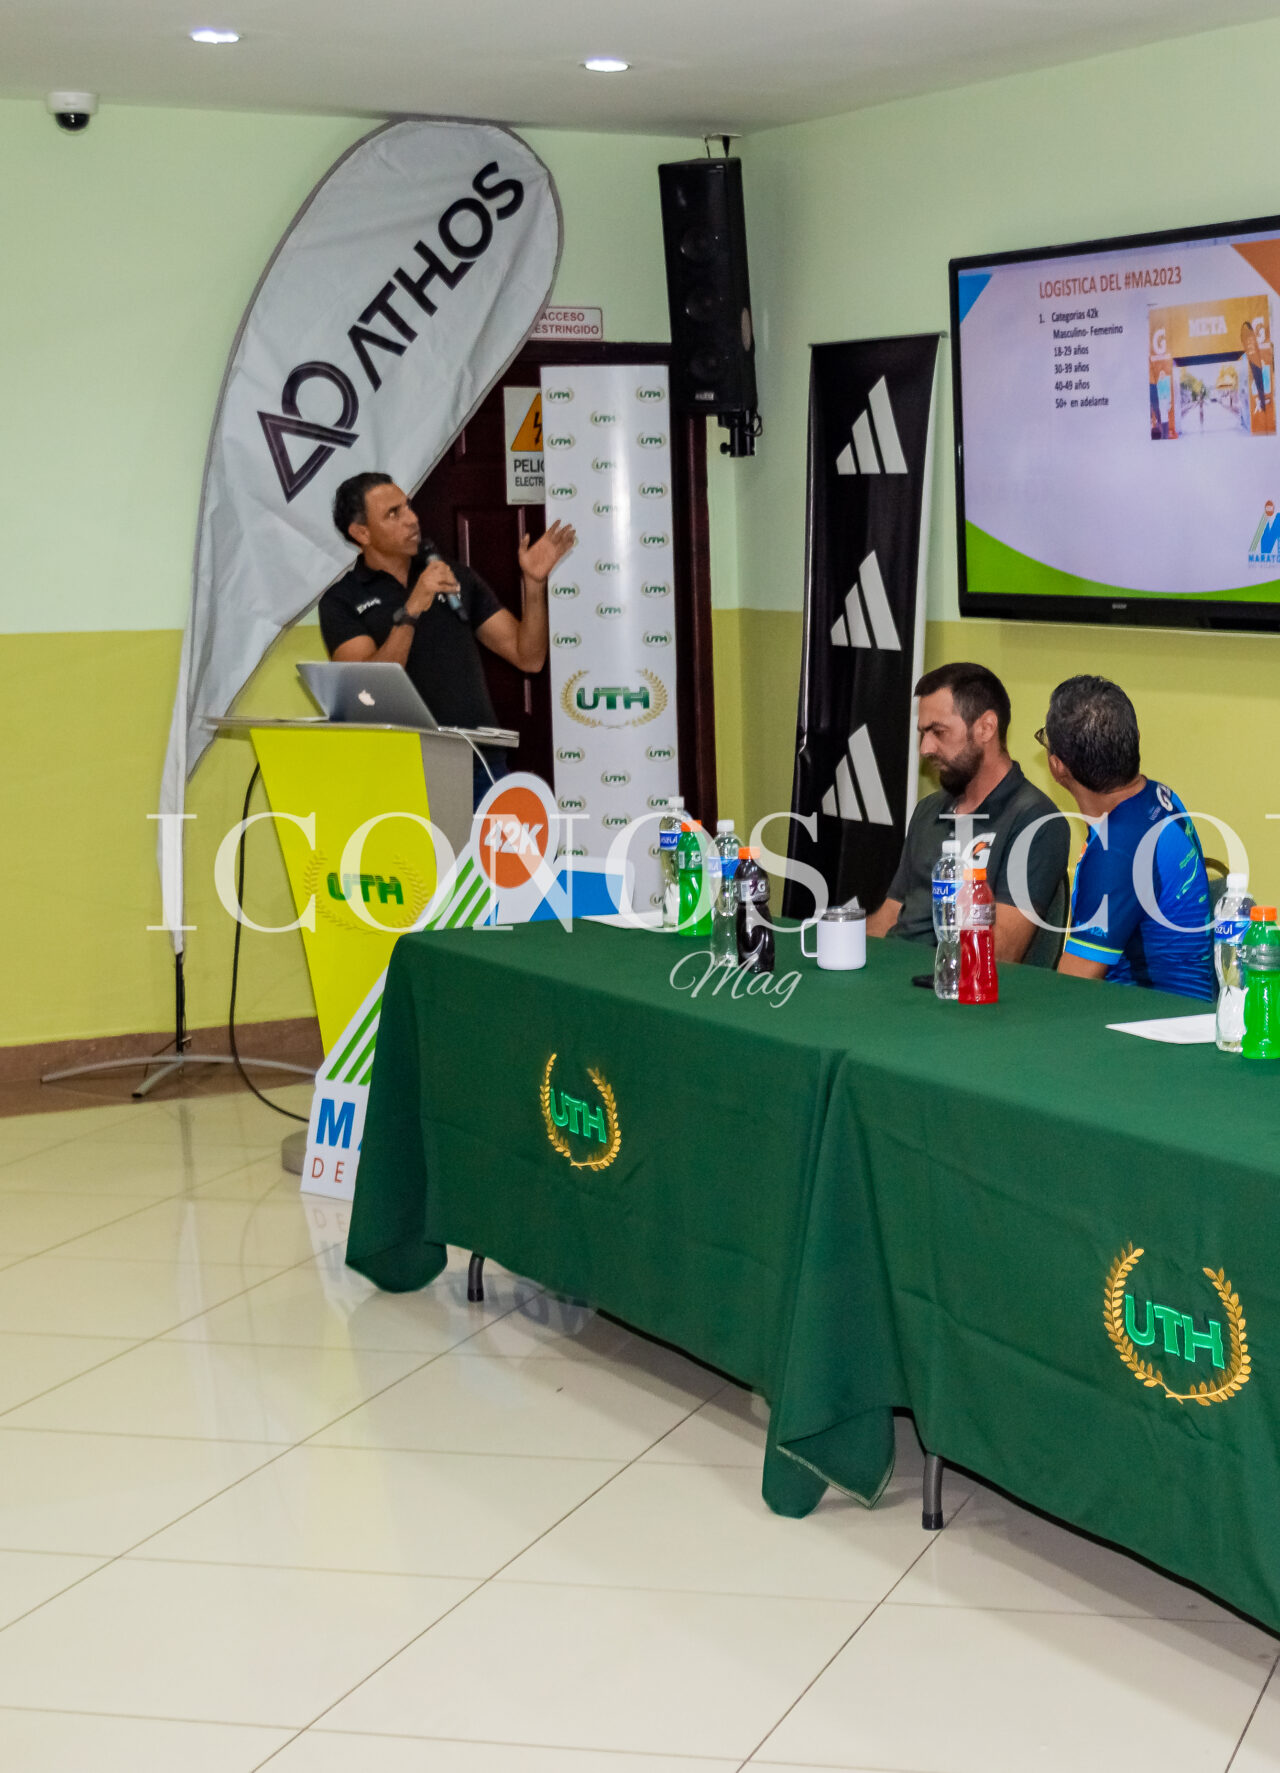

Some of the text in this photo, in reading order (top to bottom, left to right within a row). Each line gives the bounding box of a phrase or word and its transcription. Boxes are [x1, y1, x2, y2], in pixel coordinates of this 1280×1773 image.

[347, 160, 524, 393] ATHLOS
[1039, 266, 1182, 299] LOGISTICA DEL #MA2023
[533, 324, 600, 335] ESTRINGIDO
[1090, 325, 1123, 337] Femenino
[1070, 399, 1079, 407] en
[1080, 397, 1109, 407] adelante
[515, 476, 544, 487] ELECTR
[576, 686, 650, 710] UTH
[483, 820, 544, 856] 42K
[327, 872, 404, 905] UTH
[316, 1098, 362, 1153] M
[550, 1088, 607, 1144] UTH
[1124, 1294, 1225, 1370] UTH
